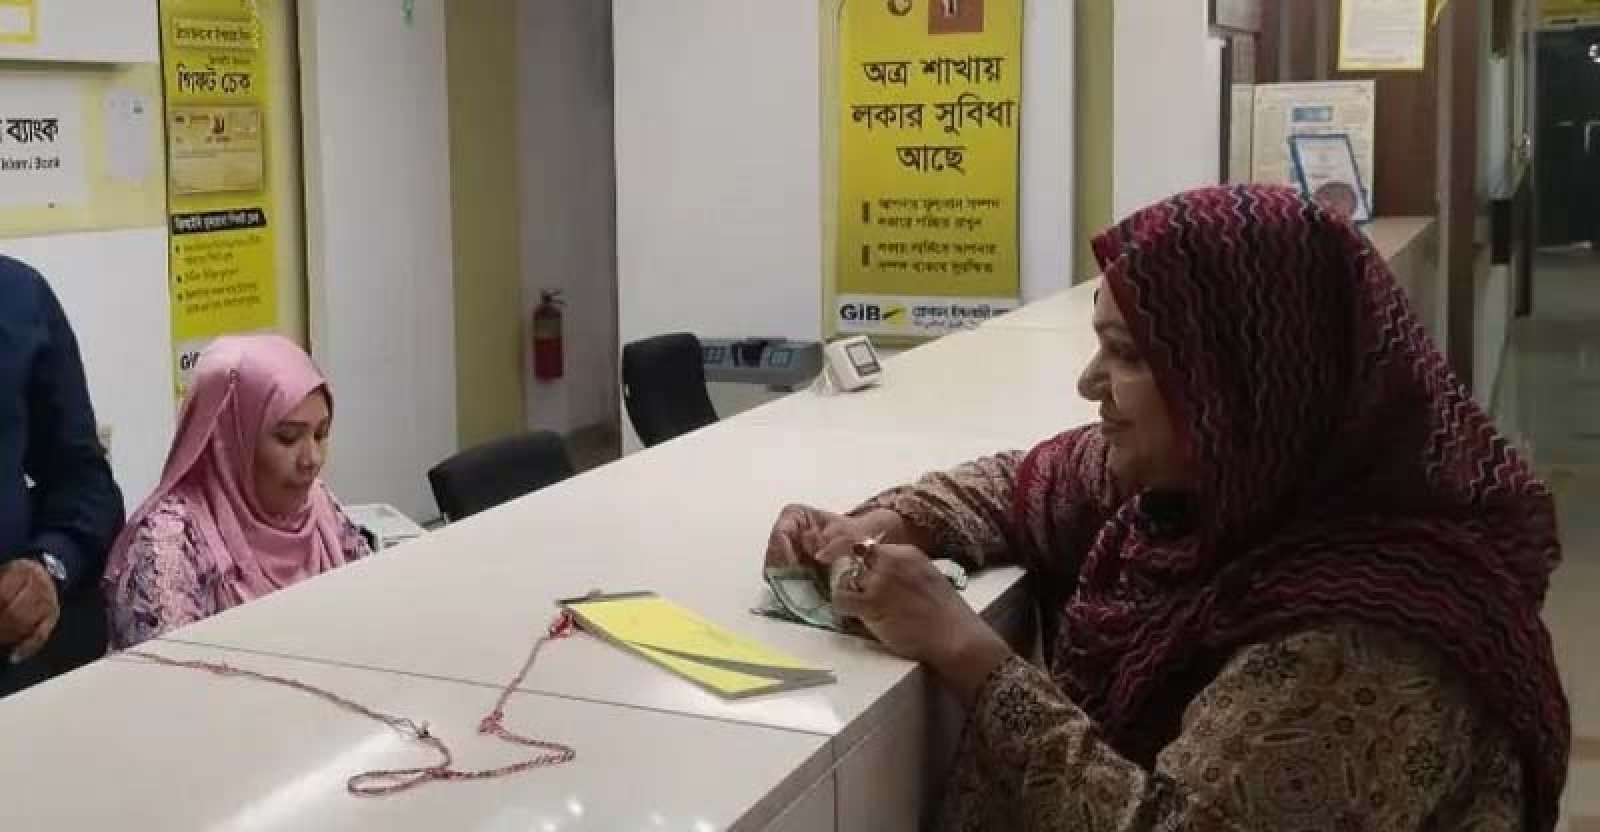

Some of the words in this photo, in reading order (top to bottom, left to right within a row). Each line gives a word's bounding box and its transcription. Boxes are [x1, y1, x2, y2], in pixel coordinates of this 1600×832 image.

[177, 62, 217, 93] গিফট
[221, 72, 252, 93] চেক
[861, 60, 913, 86] অত্র
[920, 56, 1006, 85] শাখায়
[851, 103, 925, 130] লকার
[933, 92, 1017, 136] সুবিধা
[6, 117, 58, 142] ব্যাংক
[896, 145, 966, 175] আছে
